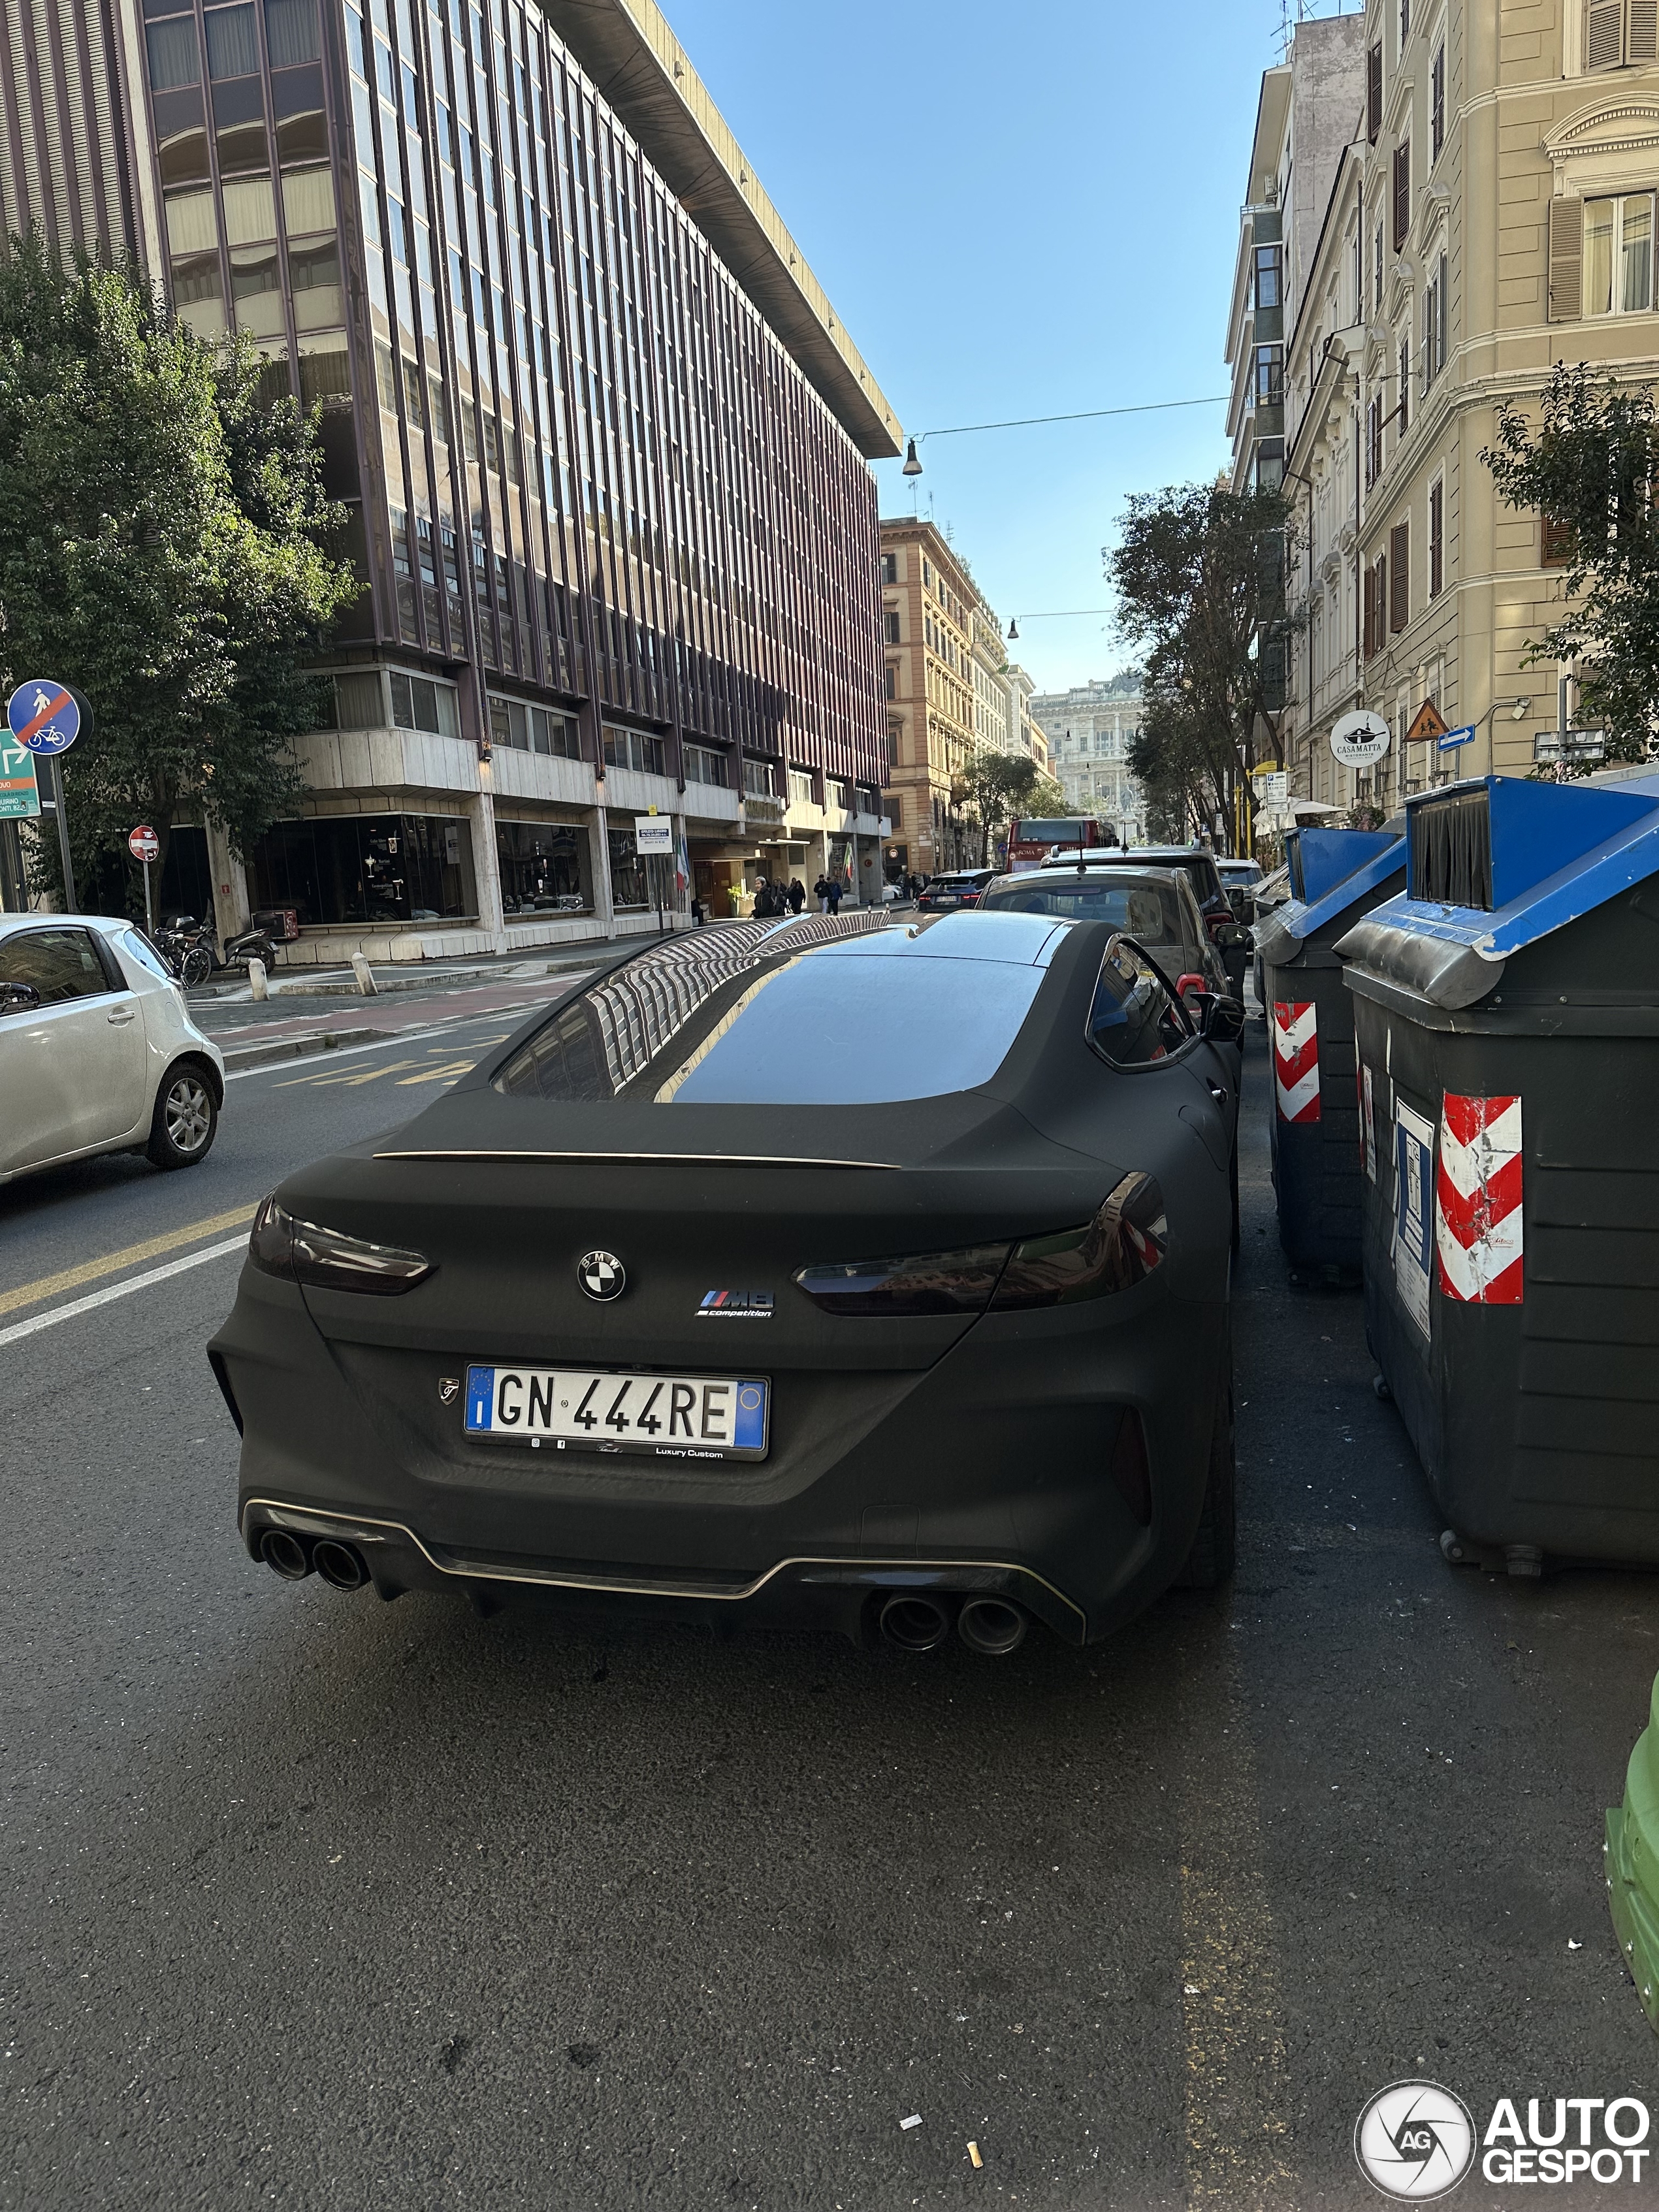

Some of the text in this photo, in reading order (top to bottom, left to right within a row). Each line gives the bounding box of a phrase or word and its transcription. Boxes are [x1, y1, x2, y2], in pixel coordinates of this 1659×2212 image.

[1337, 743, 1381, 754] CASAMATTA
[581, 1253, 620, 1270] BMW
[498, 1373, 729, 1439] GN 444RE
[656, 1447, 723, 1458] Luxury Custom
